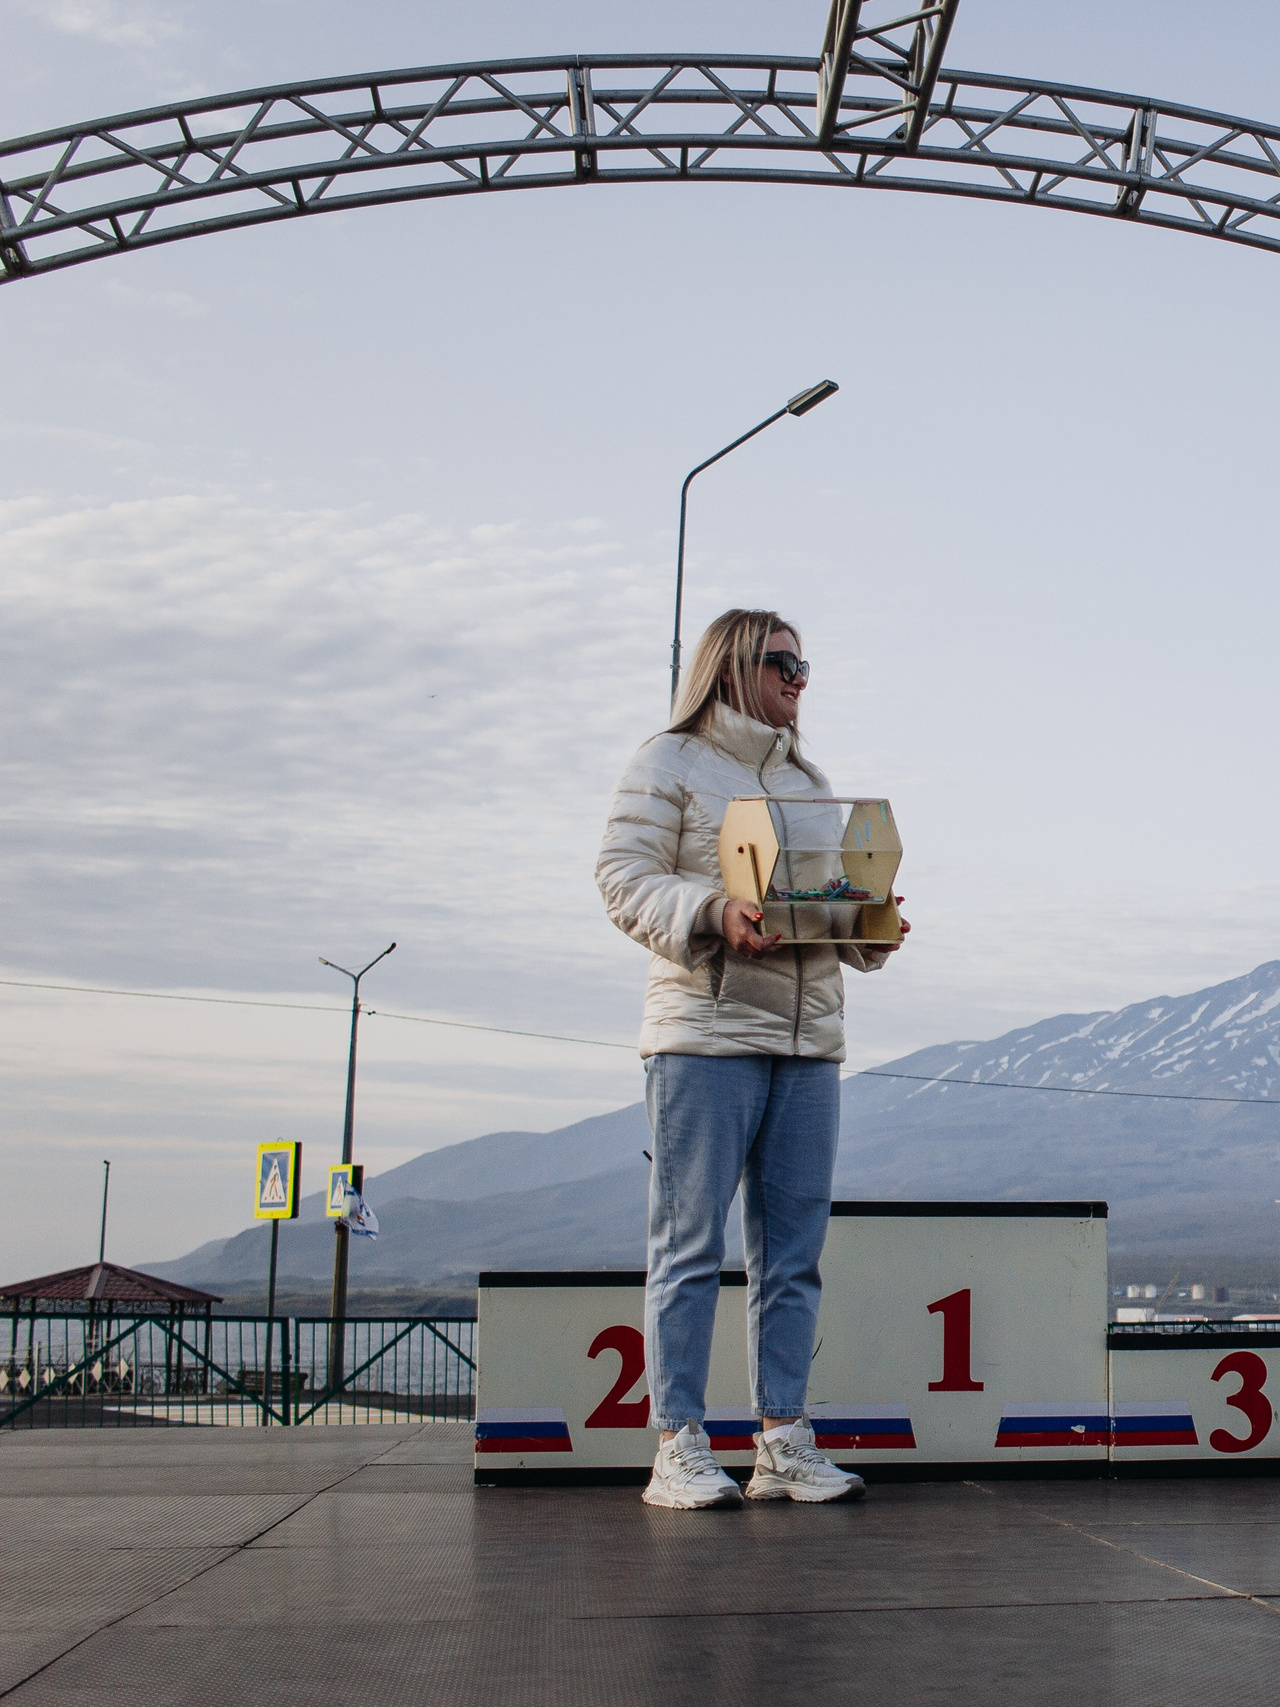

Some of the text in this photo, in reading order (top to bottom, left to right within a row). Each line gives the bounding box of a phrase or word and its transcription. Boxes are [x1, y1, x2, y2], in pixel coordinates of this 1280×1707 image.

[585, 1325, 650, 1429] 2
[927, 1288, 984, 1391] 1
[1210, 1351, 1273, 1453] 3
